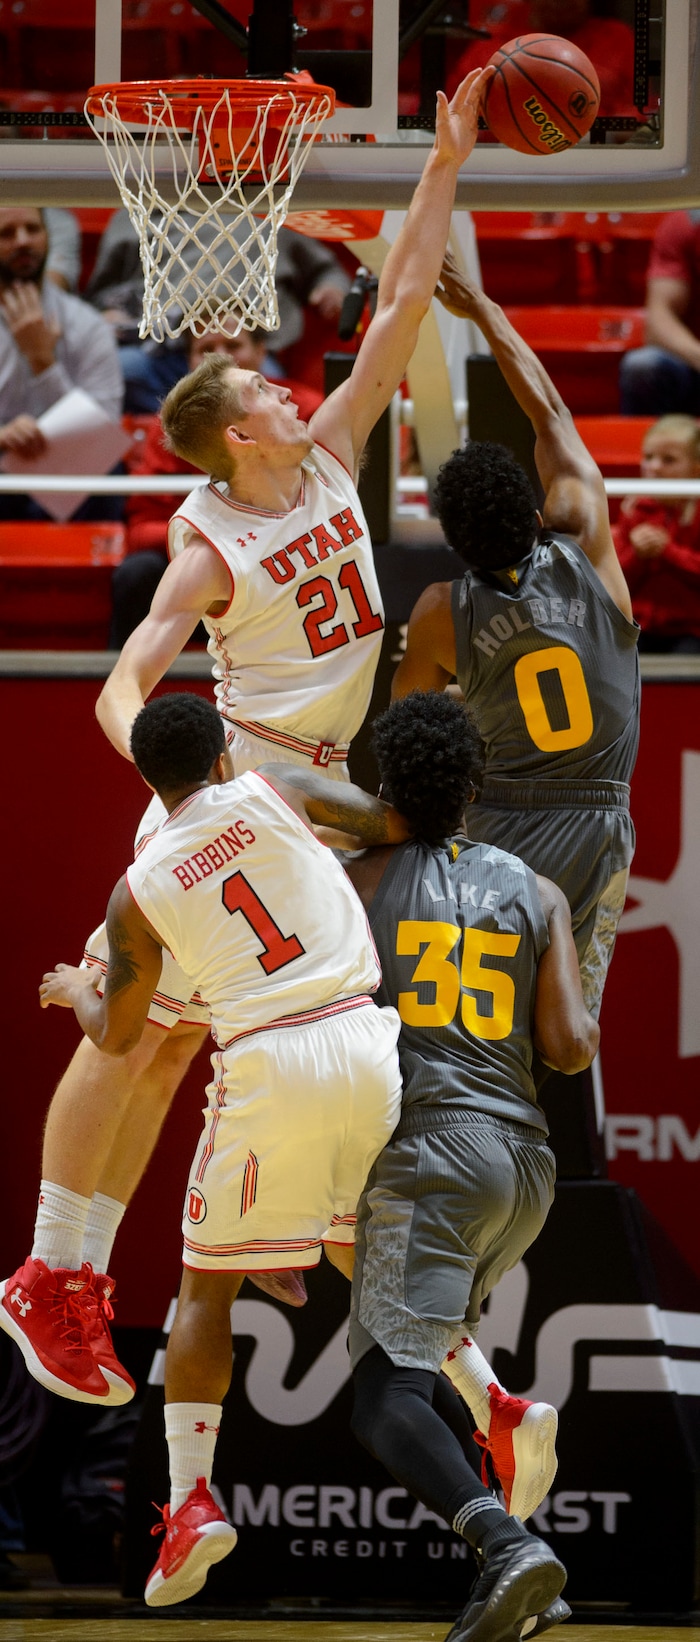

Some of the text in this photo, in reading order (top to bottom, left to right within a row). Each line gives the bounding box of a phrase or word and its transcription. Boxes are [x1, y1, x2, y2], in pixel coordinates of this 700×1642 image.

[523, 95, 573, 153] Wilson
[260, 507, 364, 585] UTAH
[295, 559, 384, 659] 21
[473, 598, 587, 659] HOLDER
[514, 646, 594, 753] 0
[172, 820, 256, 891] BIBBINS
[221, 869, 306, 976] 1
[396, 920, 521, 1041] 35
[290, 1539, 408, 1558] CREDIT
